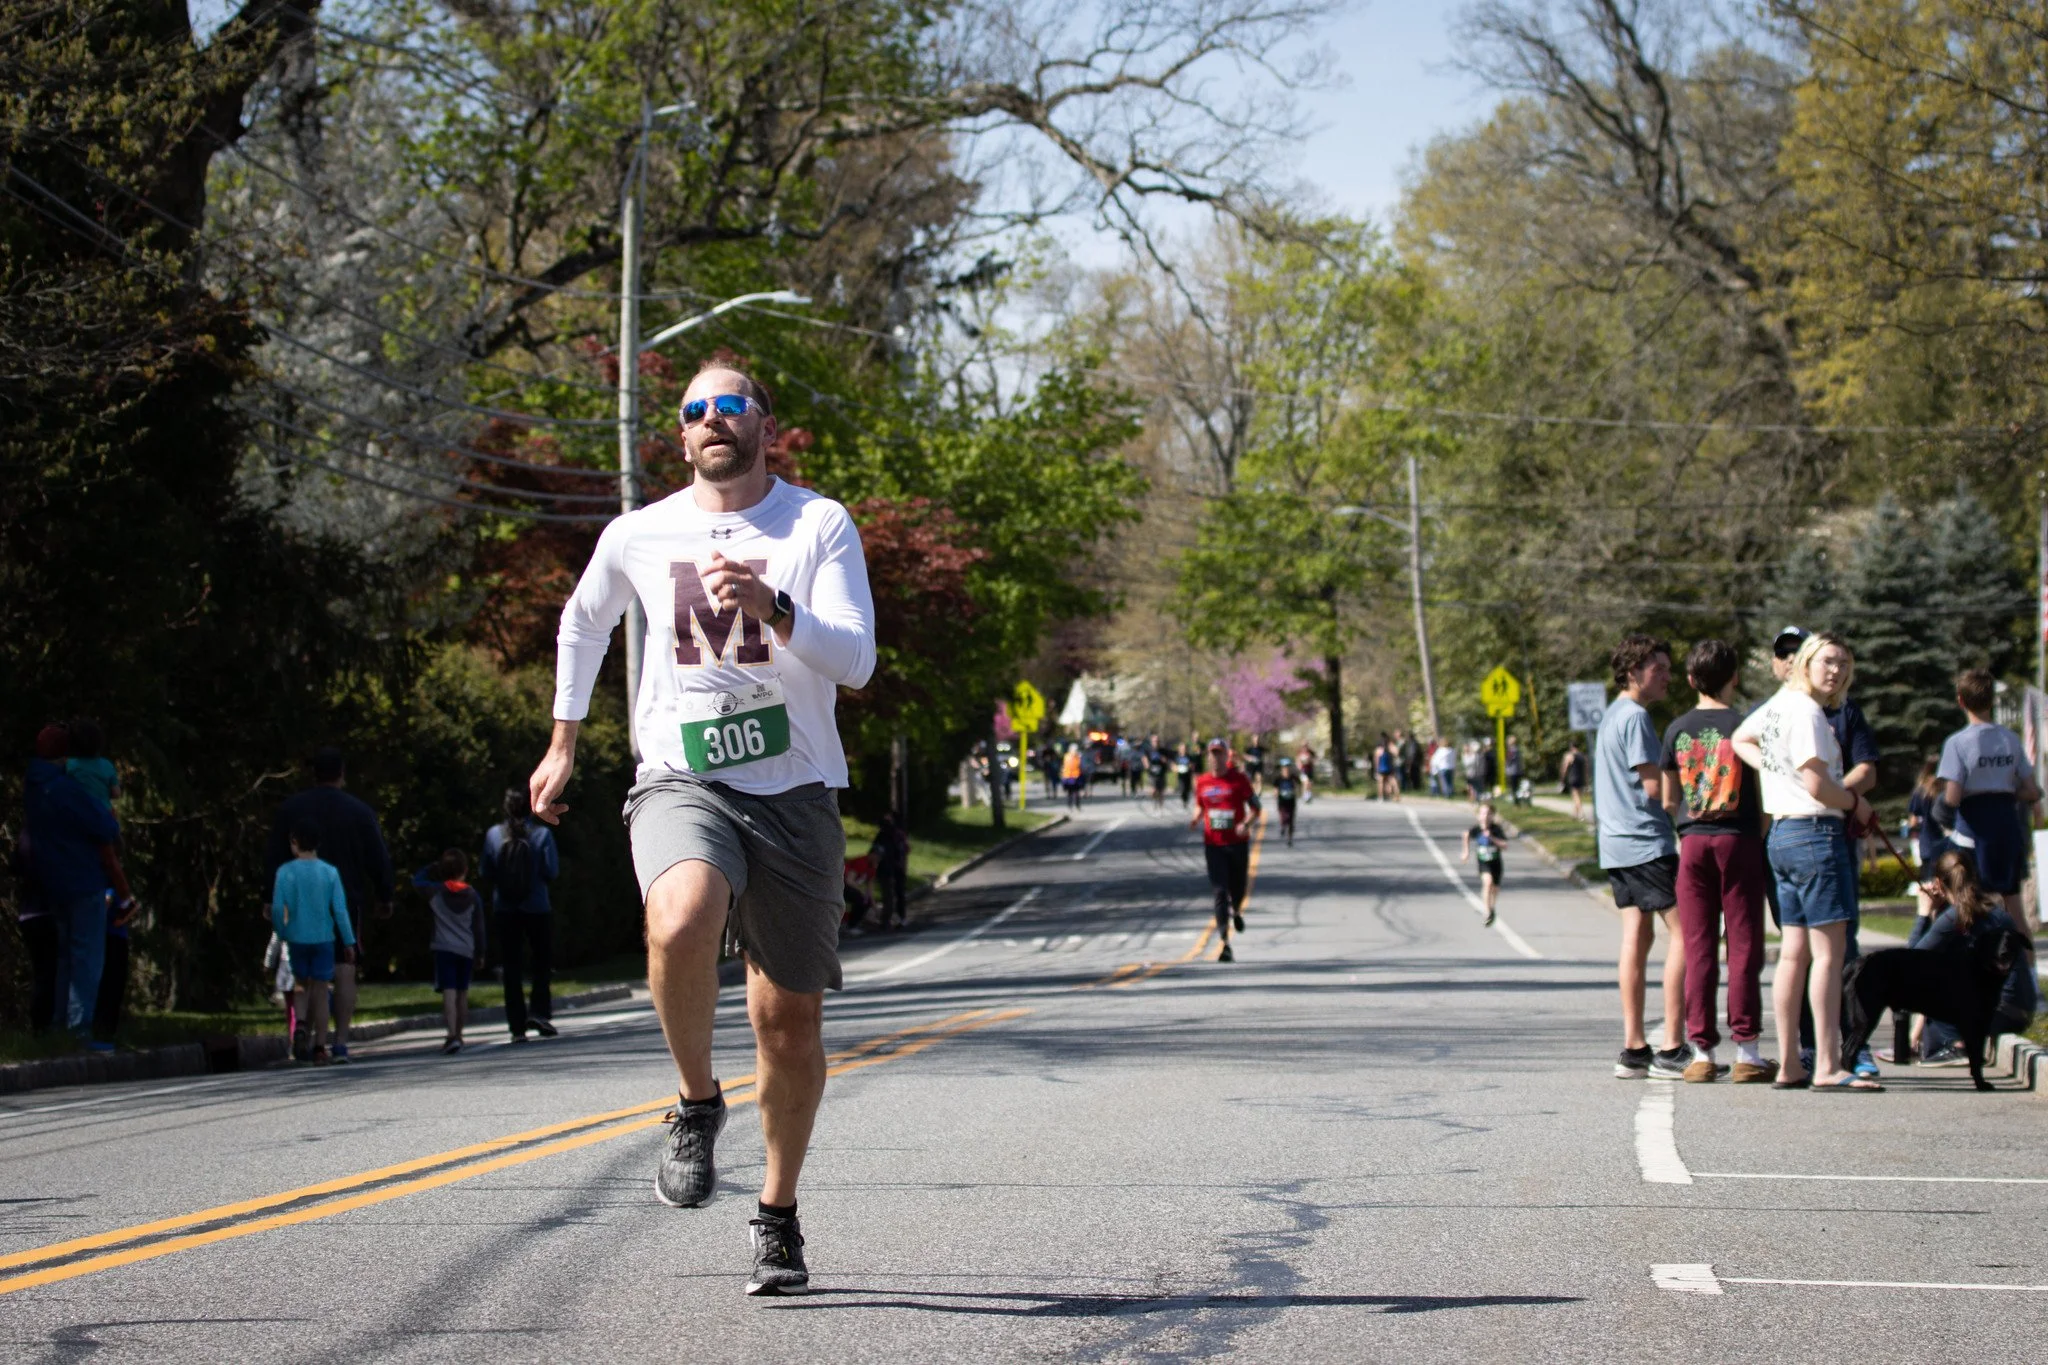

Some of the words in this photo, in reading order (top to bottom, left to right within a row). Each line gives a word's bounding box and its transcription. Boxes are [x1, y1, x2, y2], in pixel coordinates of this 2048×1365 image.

[668, 557, 773, 668] M
[1576, 708, 1603, 725] 30
[703, 718, 766, 765] 306
[1979, 755, 2014, 768] DYER
